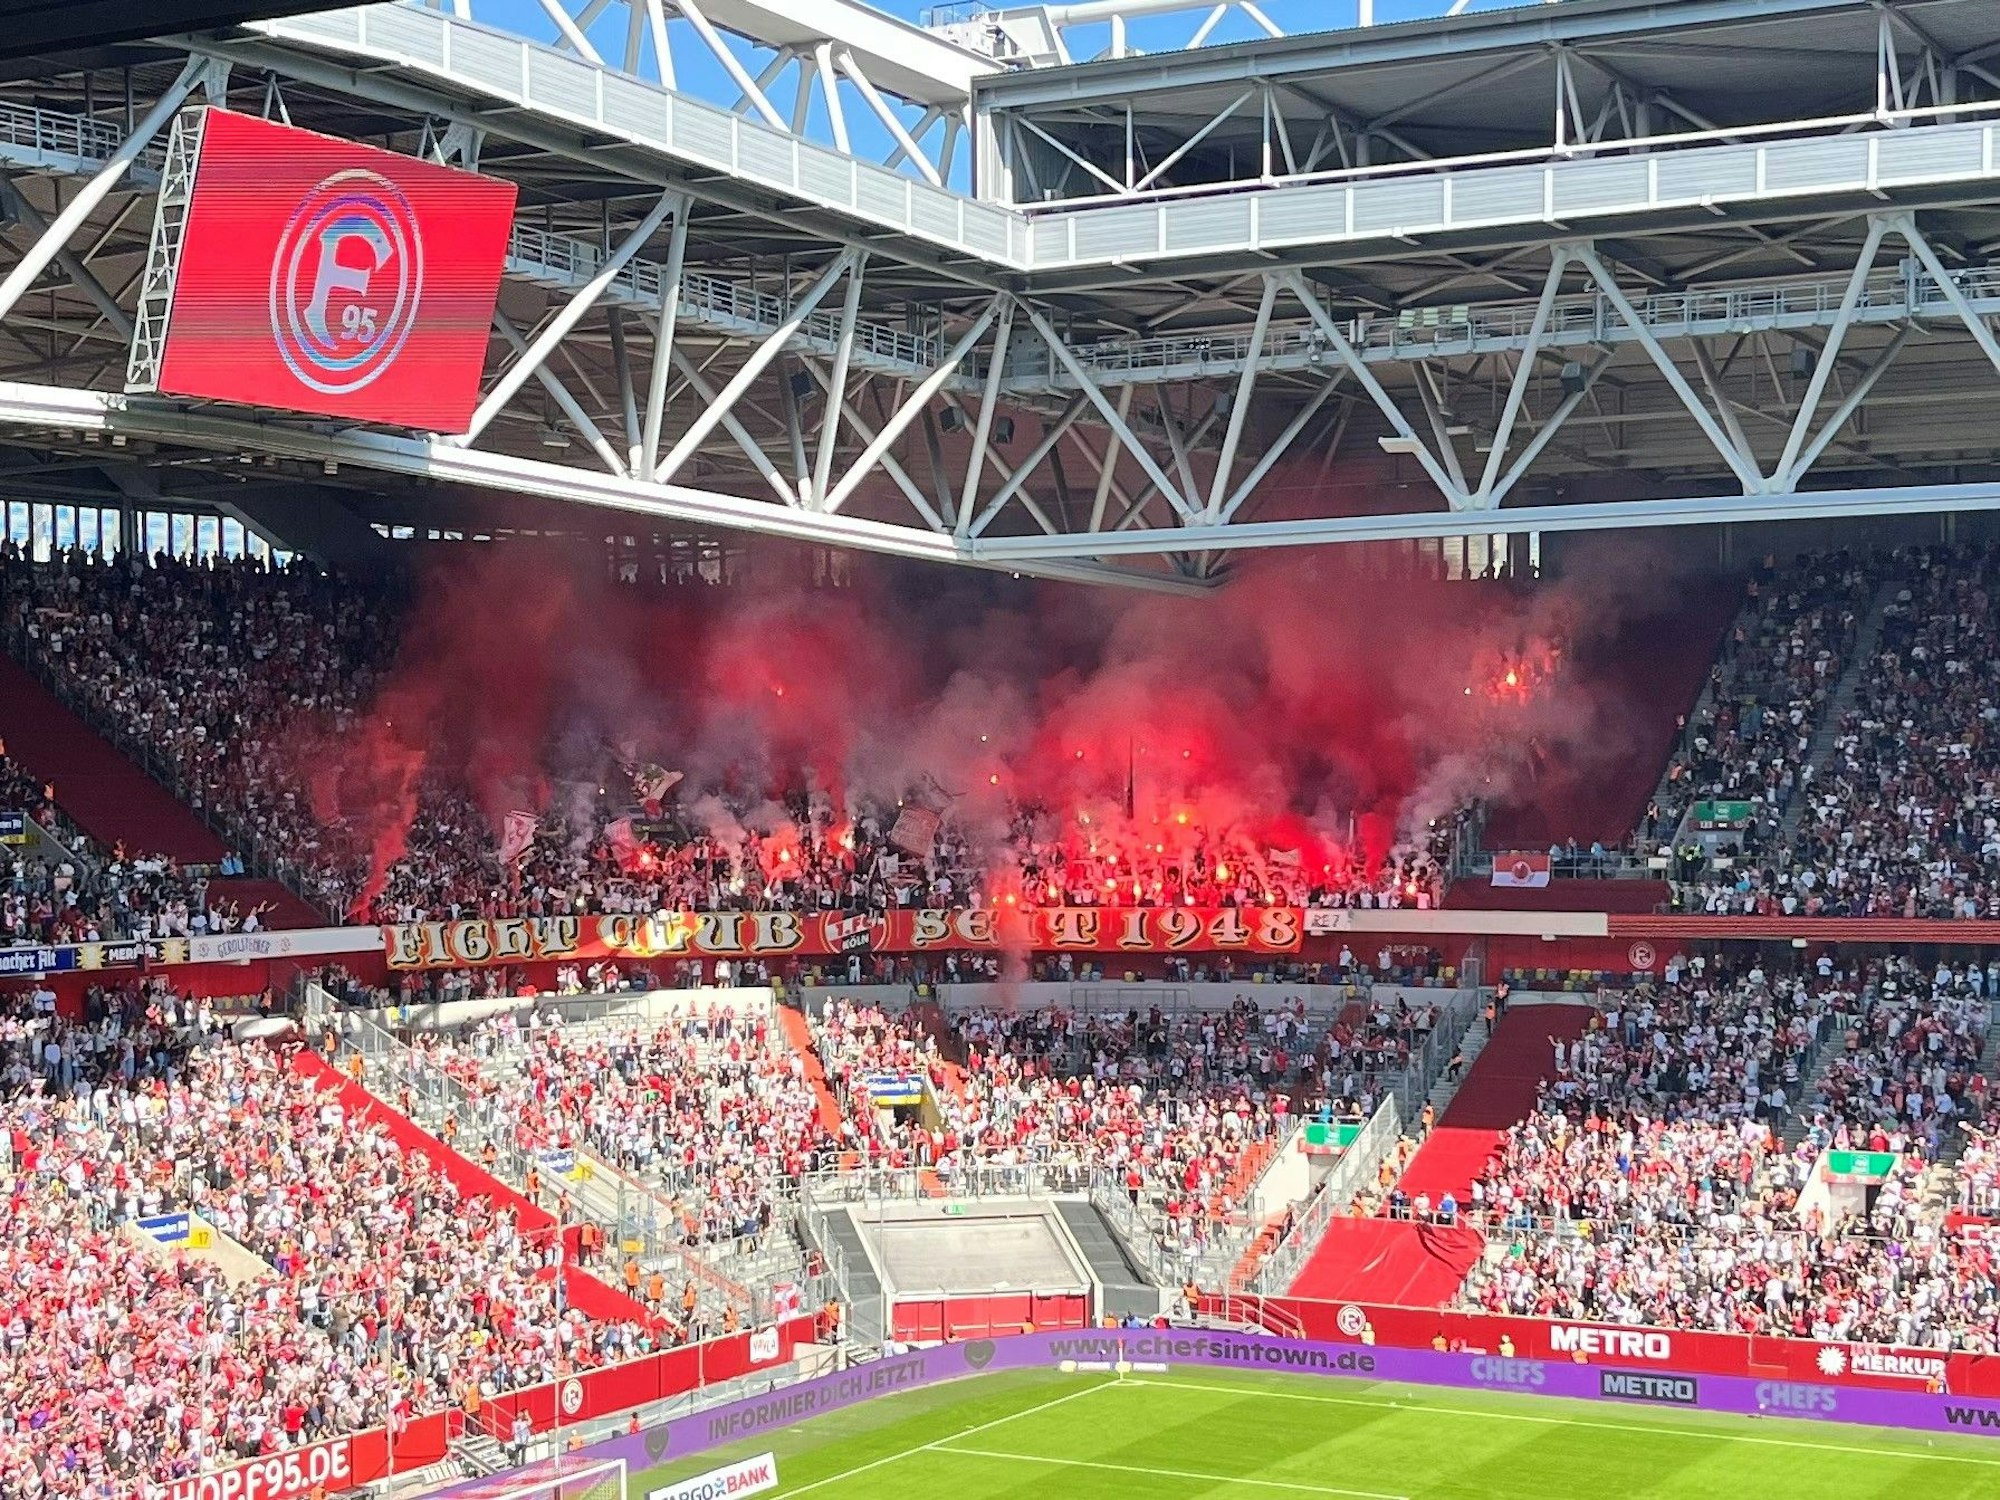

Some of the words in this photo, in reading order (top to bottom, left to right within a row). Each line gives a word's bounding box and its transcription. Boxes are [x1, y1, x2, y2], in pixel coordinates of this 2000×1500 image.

[1117, 907, 1299, 950] 1948
[38, 949, 57, 970] Alt
[1048, 1336, 1376, 1373] www.chefsintown.de
[1550, 1325, 1671, 1360] METRO
[1470, 1356, 1546, 1385] CHEFS
[1851, 1354, 1946, 1375] MERKUR
[708, 1391, 815, 1441] INFORMIER
[820, 1374, 862, 1407] DICH
[866, 1358, 925, 1392] JETZT!
[1603, 1373, 1694, 1401] METRO
[1755, 1381, 1837, 1412] CHEFS
